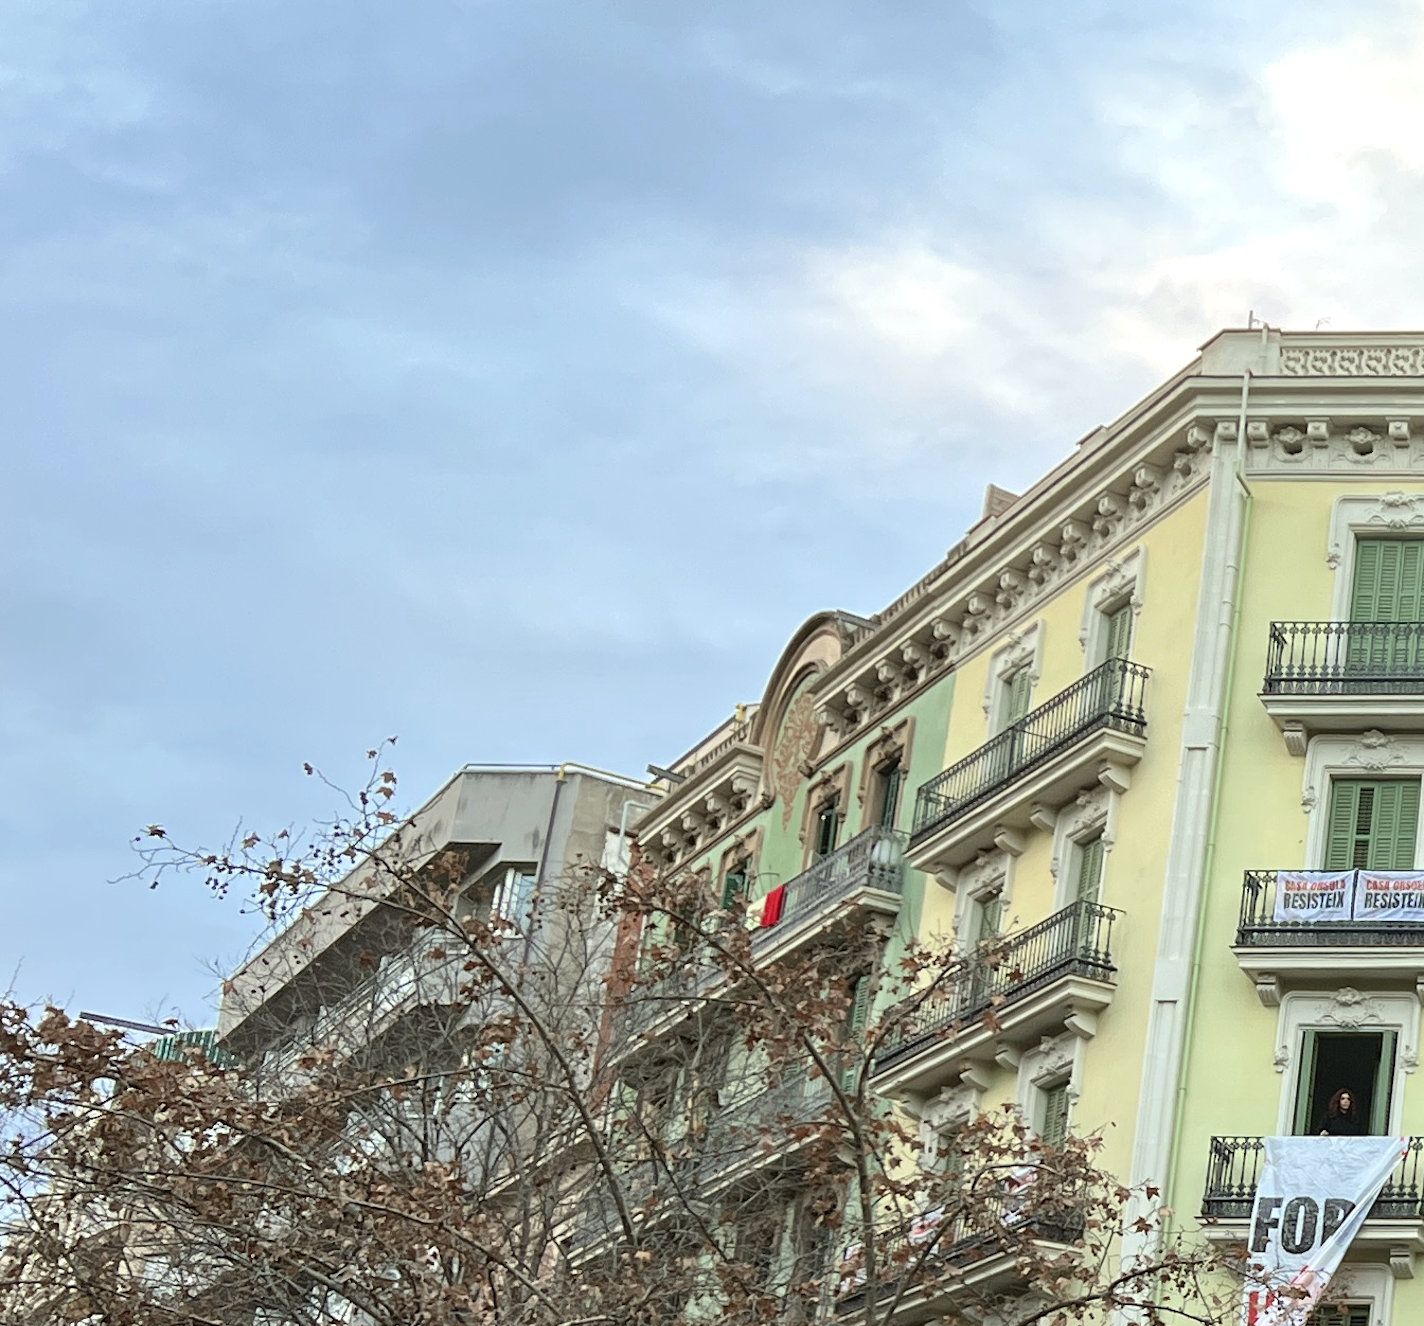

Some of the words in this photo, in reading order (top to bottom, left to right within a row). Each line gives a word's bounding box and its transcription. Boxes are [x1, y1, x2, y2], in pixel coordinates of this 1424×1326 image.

[1285, 880, 1307, 891] CASA
[1311, 880, 1346, 891] ORSOLA
[1366, 880, 1389, 891] CASA
[1284, 891, 1345, 909] RESISTEIX
